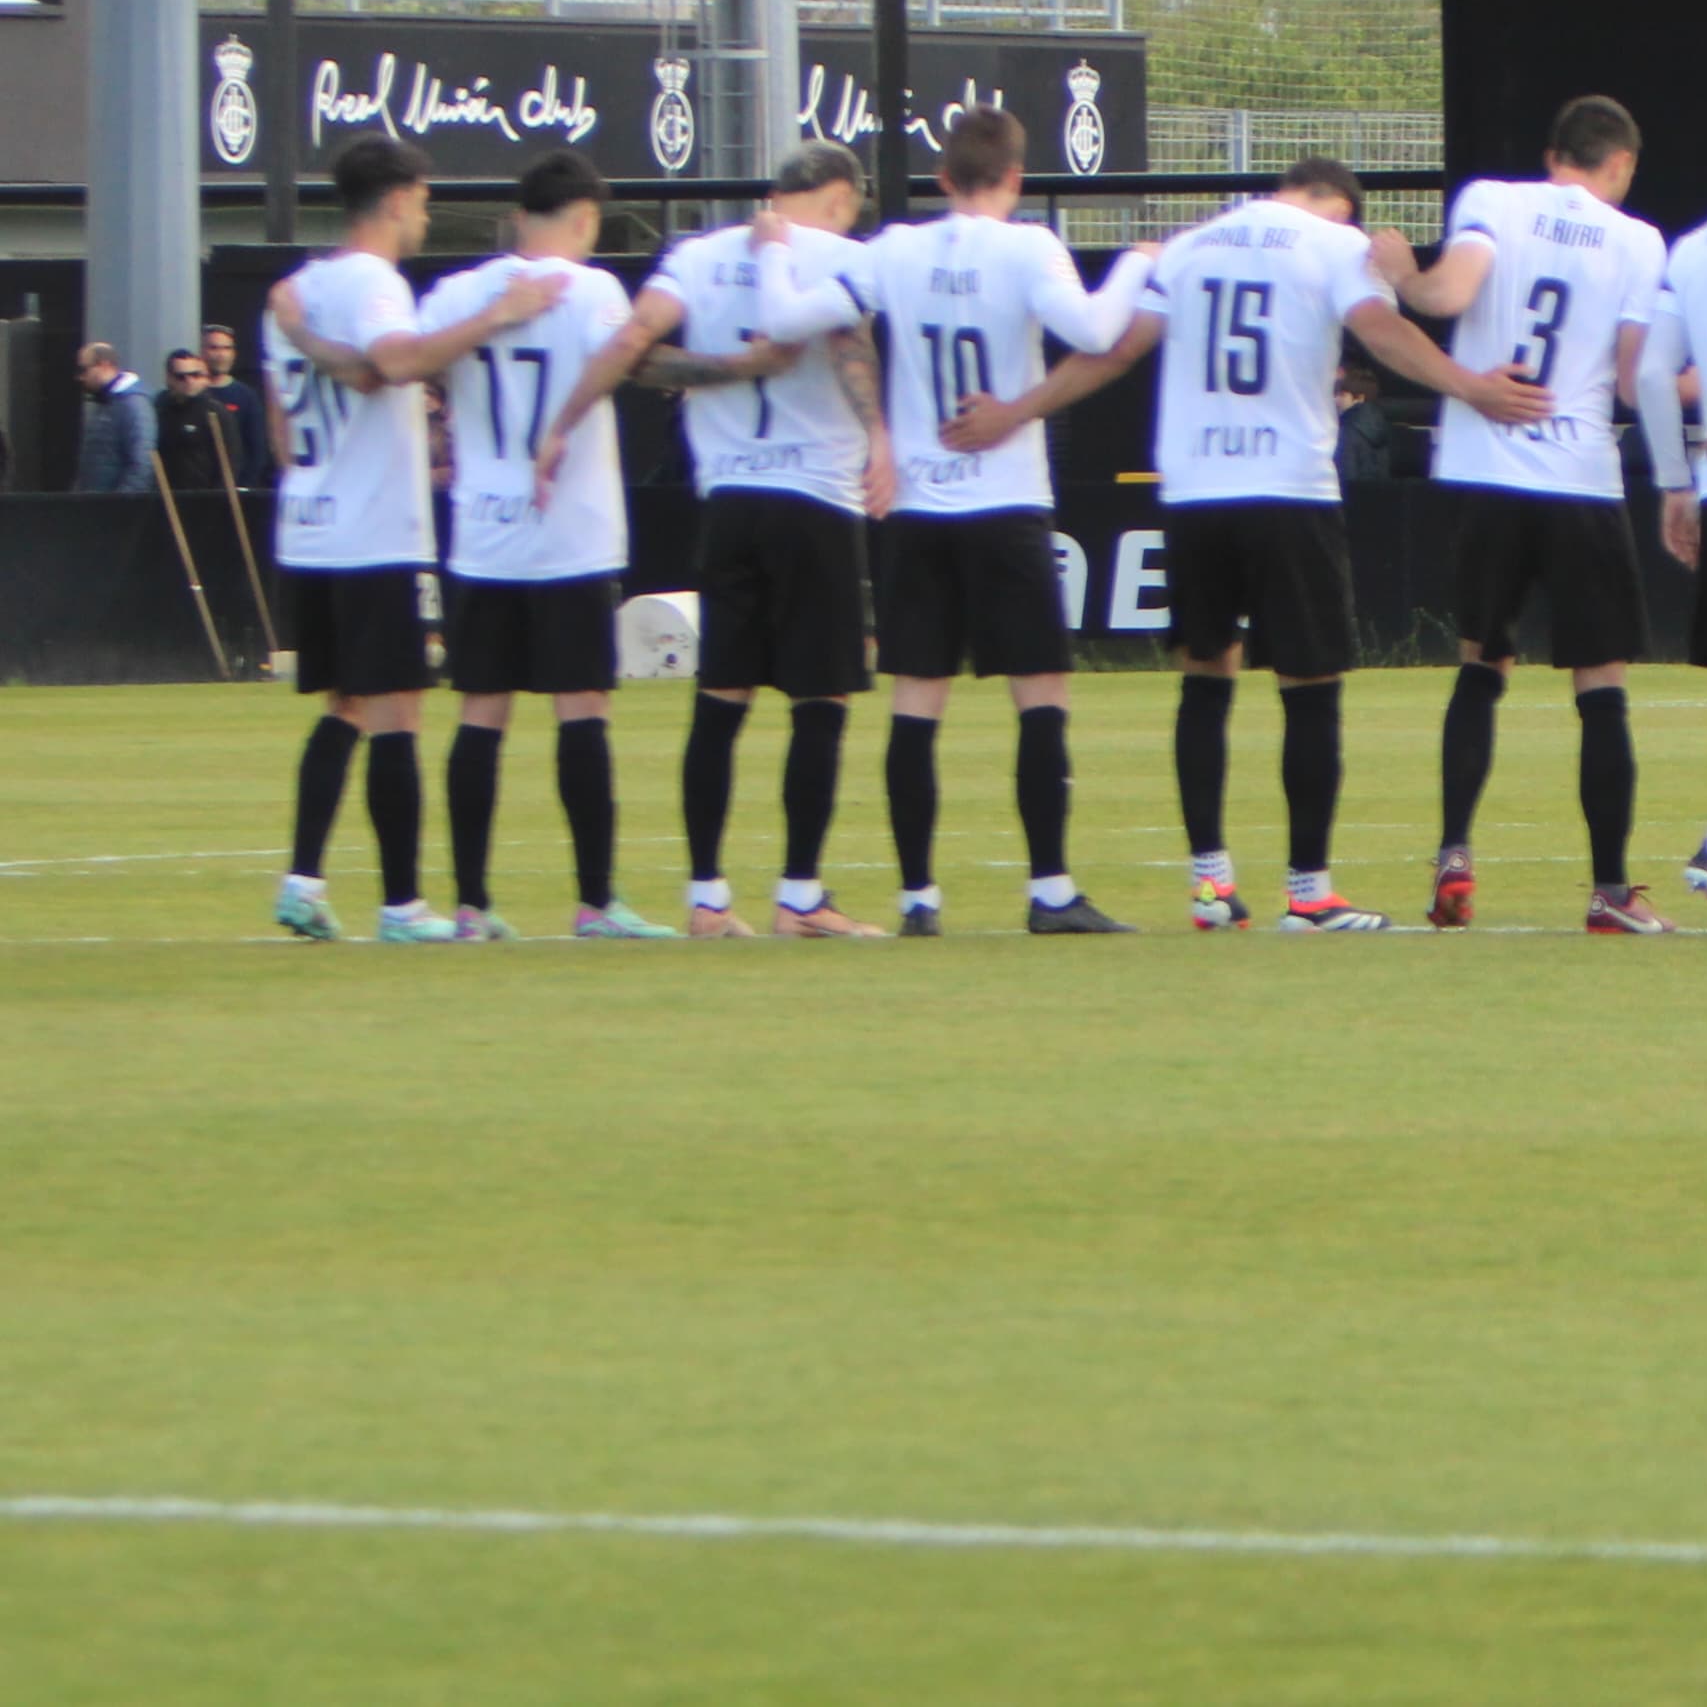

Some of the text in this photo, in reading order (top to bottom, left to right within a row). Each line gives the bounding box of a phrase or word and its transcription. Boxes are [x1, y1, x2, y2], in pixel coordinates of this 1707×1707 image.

[920, 322, 993, 424] 10
[1200, 277, 1276, 395] 15
[1513, 277, 1572, 387] 3
[474, 345, 551, 462] 17
